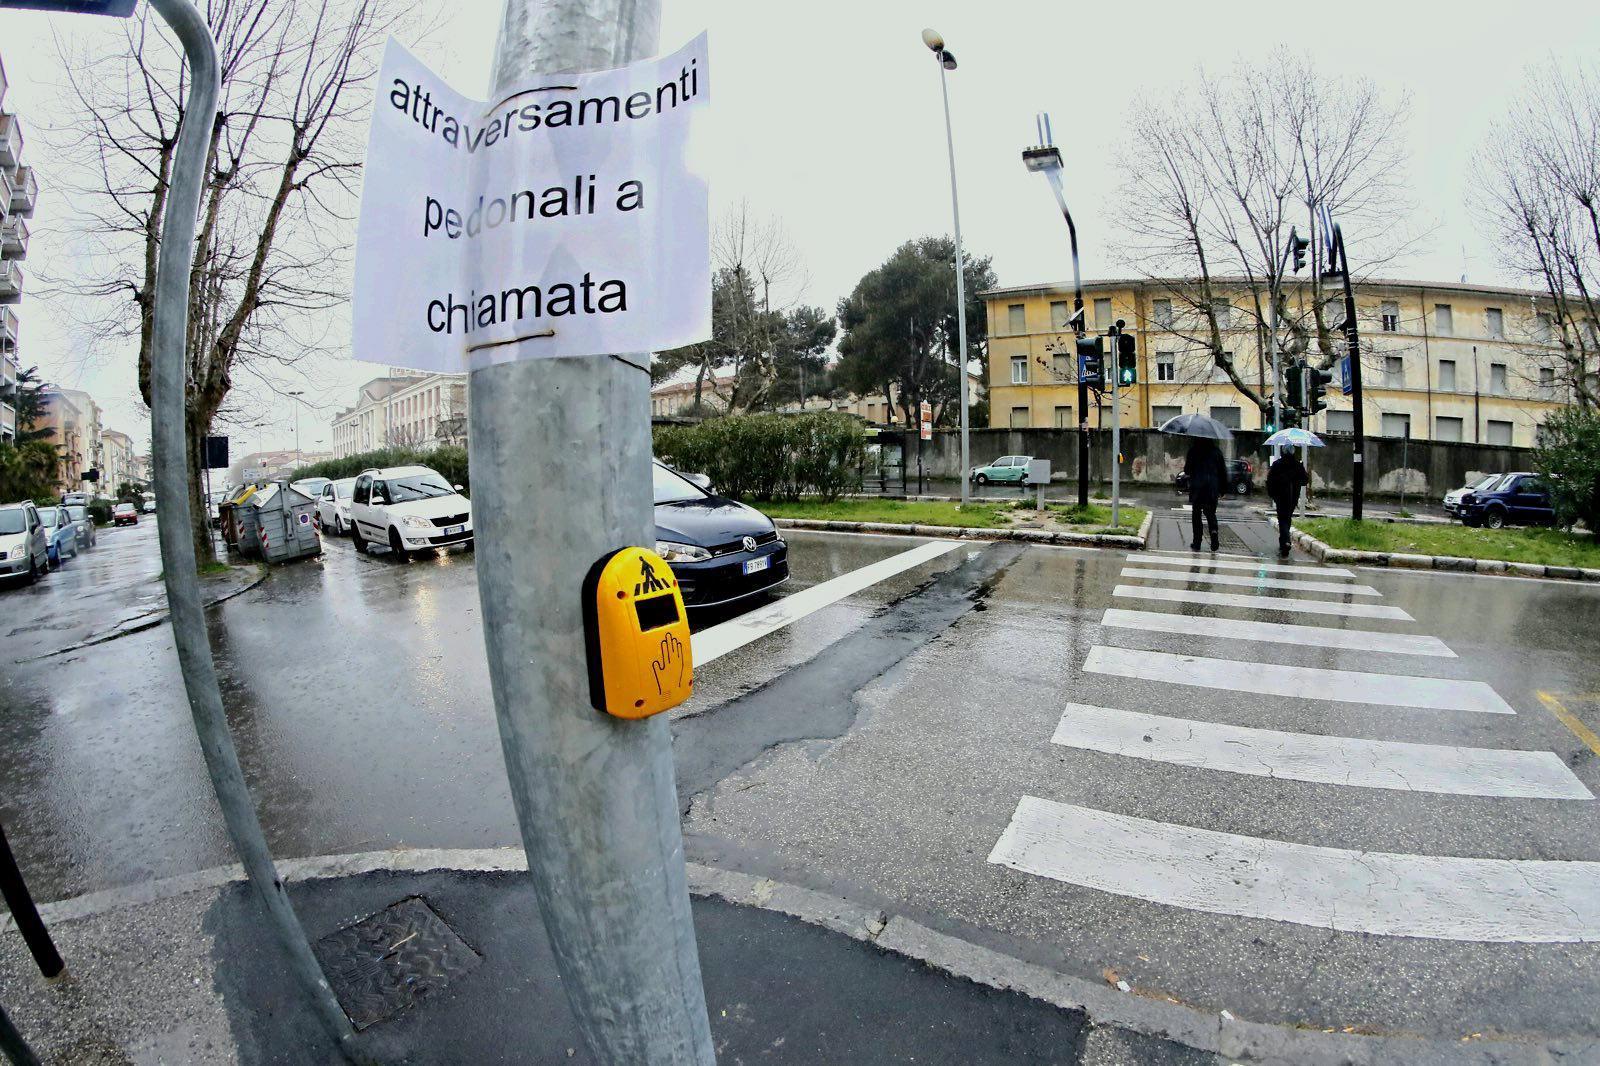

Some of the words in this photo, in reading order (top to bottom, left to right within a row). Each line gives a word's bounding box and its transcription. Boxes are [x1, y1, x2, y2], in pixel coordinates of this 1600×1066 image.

[390, 58, 698, 153] attraversamenti
[424, 174, 596, 239] pedonali
[616, 179, 645, 211] a
[427, 272, 627, 334] chiamata
